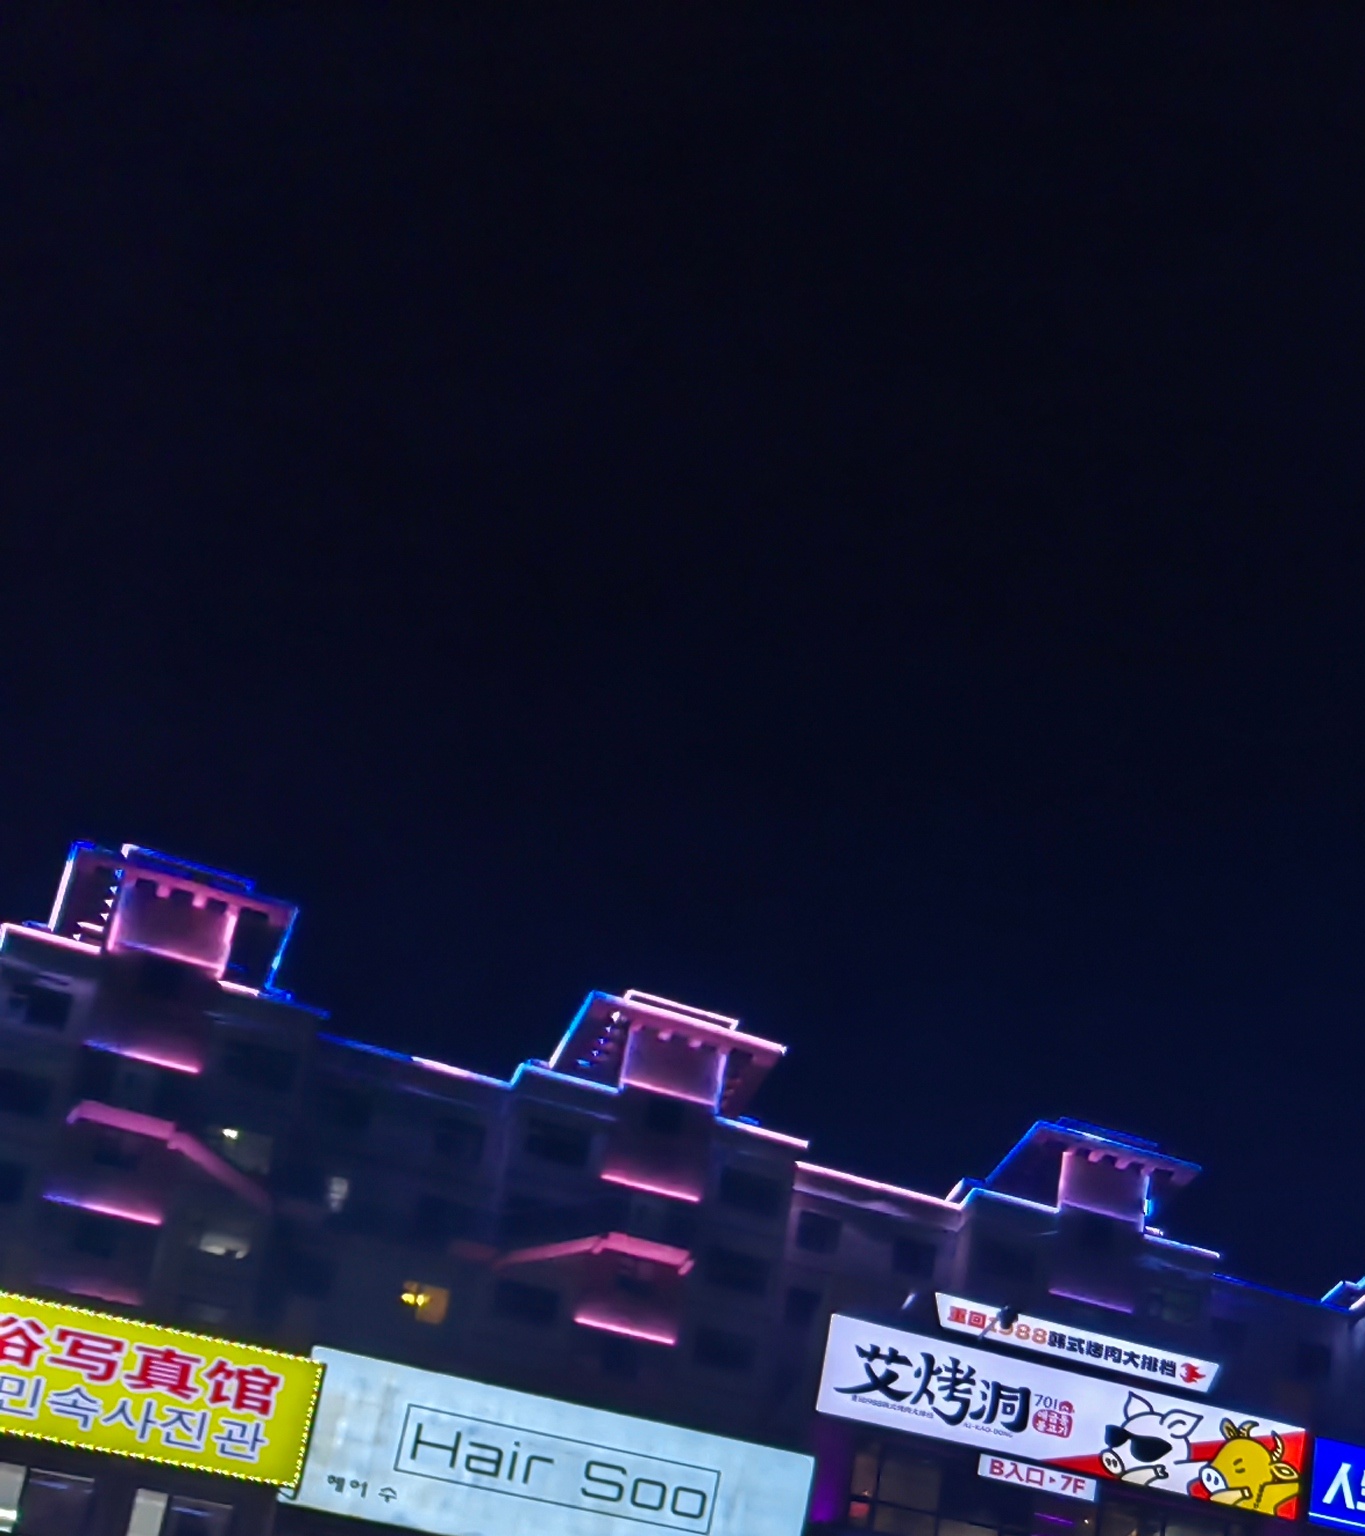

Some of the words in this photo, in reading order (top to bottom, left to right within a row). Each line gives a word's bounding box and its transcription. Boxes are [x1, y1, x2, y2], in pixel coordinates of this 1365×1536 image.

[834, 1343, 1031, 1433] 艾烤洞
[408, 1422, 556, 1487] Hair
[580, 1459, 708, 1519] Soo
[990, 1458, 1045, 1486] B入口
[1061, 1474, 1086, 1494] 7F
